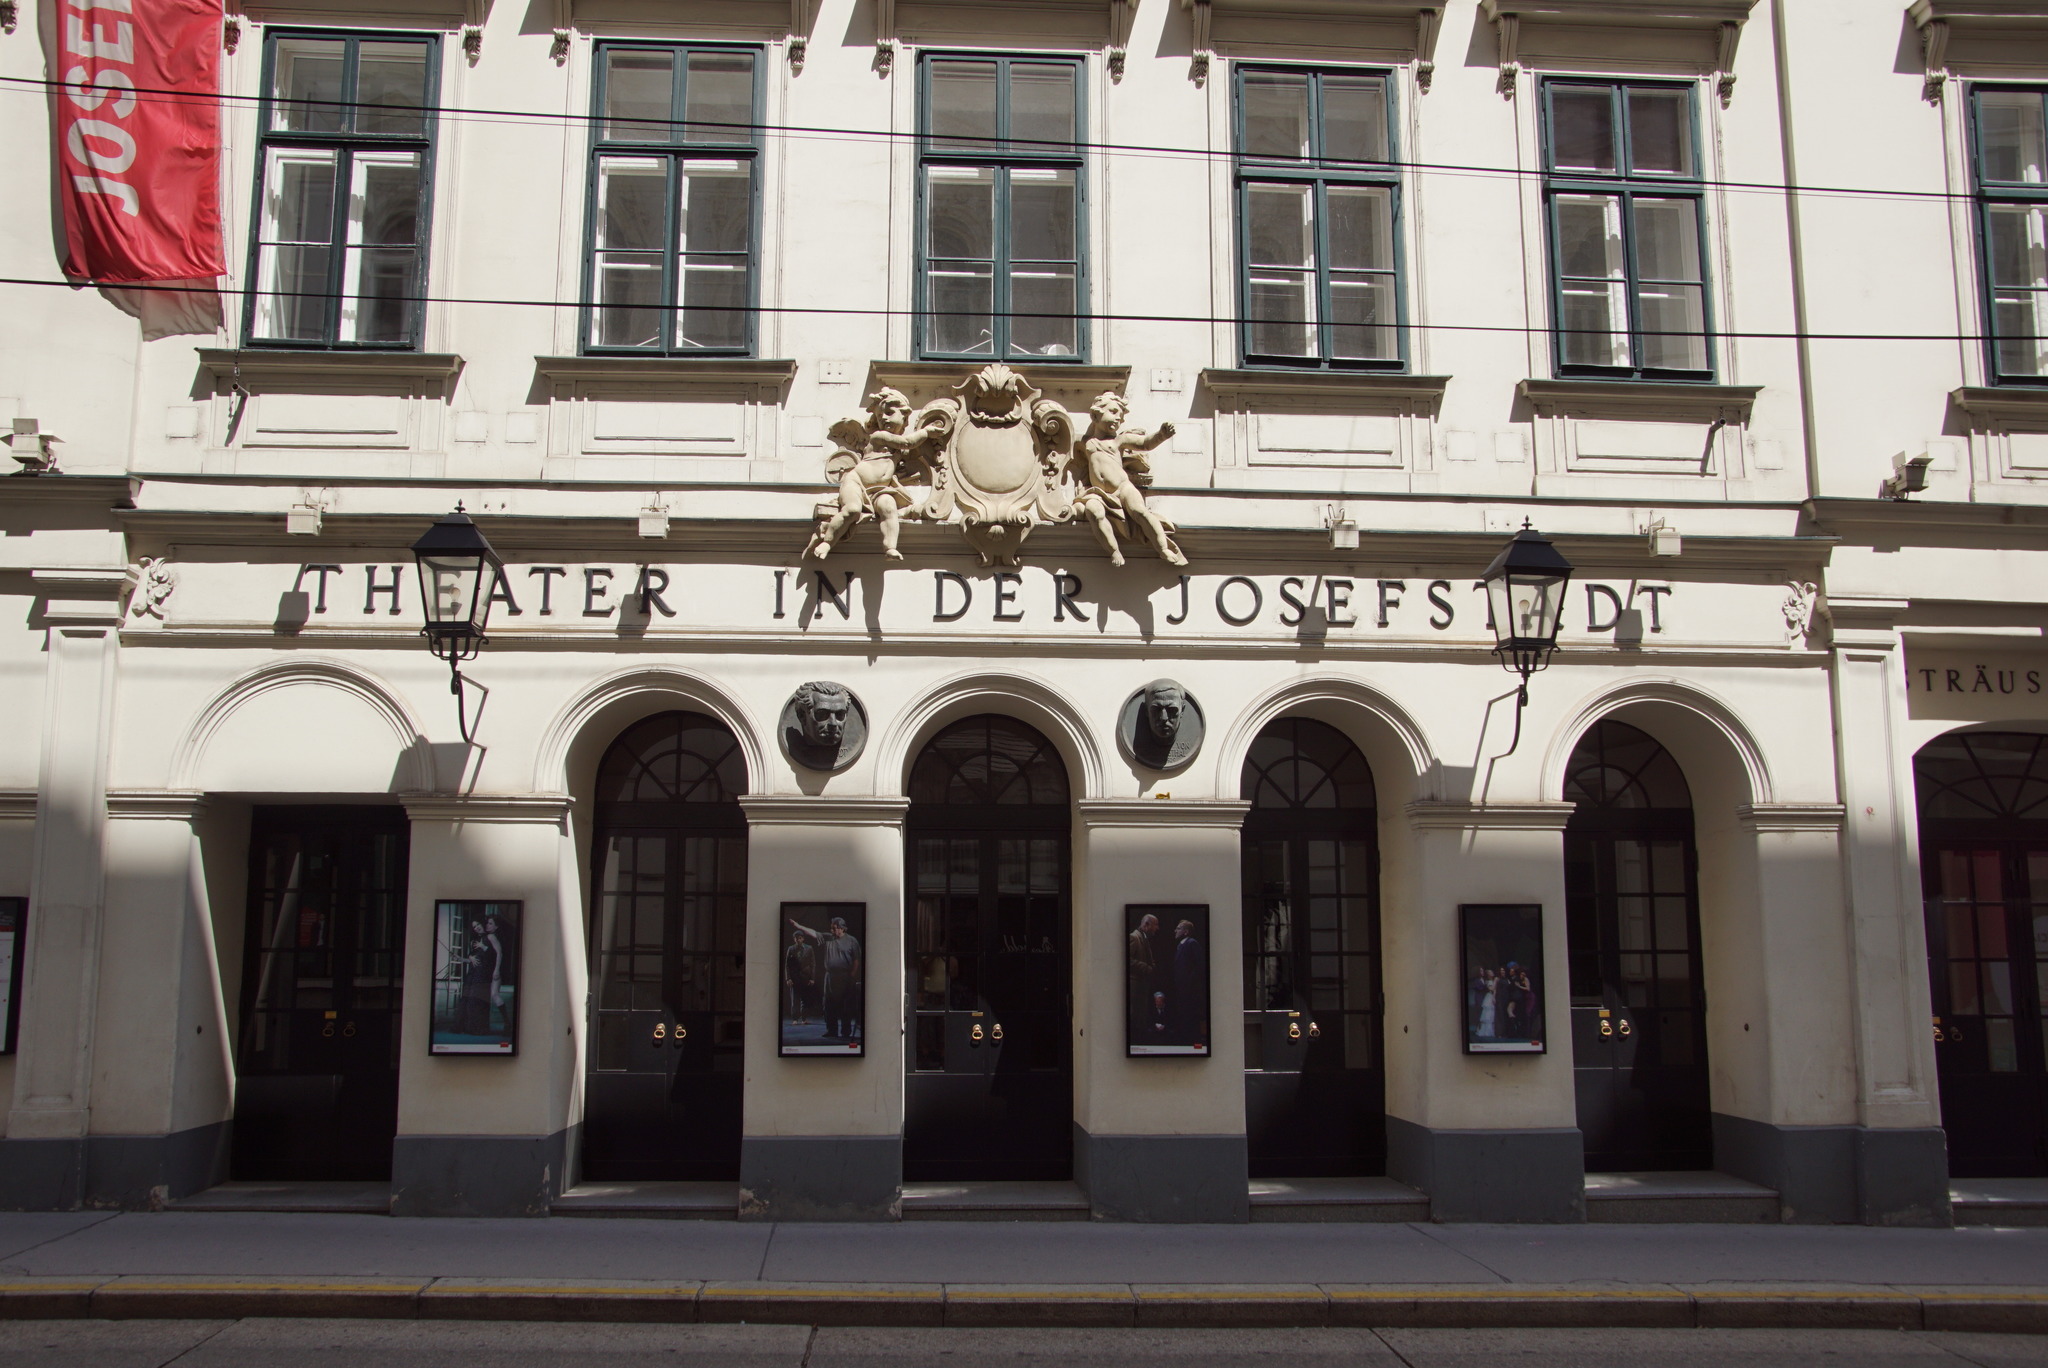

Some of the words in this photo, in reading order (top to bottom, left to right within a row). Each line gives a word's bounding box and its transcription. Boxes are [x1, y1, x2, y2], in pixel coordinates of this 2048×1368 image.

[305, 563, 677, 618] THEATER
[773, 569, 854, 620] IN
[933, 570, 1090, 623] DER
[1166, 574, 1672, 633] JOSEFSTADT
[1905, 664, 2041, 695] TRÄUS
